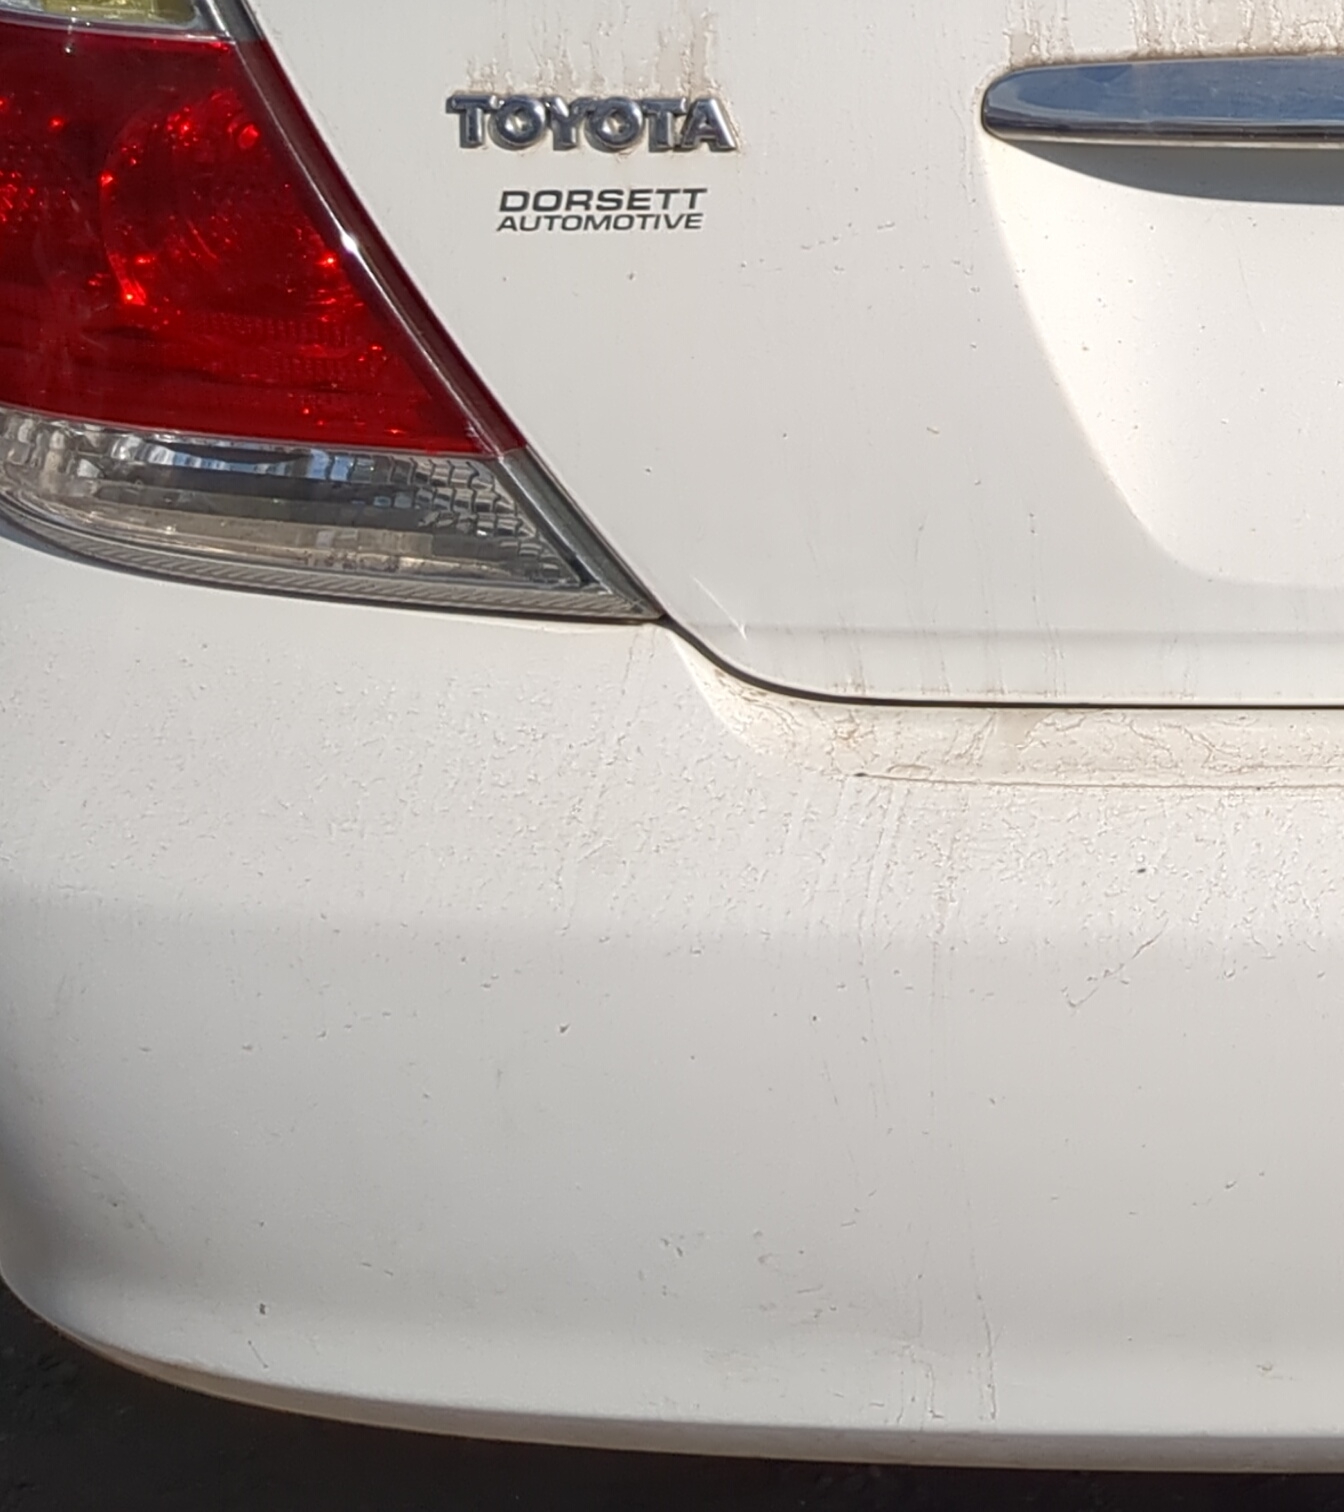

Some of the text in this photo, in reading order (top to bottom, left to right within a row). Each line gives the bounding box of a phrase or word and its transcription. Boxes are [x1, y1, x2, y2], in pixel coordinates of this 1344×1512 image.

[446, 93, 740, 152] TOYOTA
[499, 188, 708, 212] DORSETT
[496, 213, 704, 232] AUTOMOTIVE
